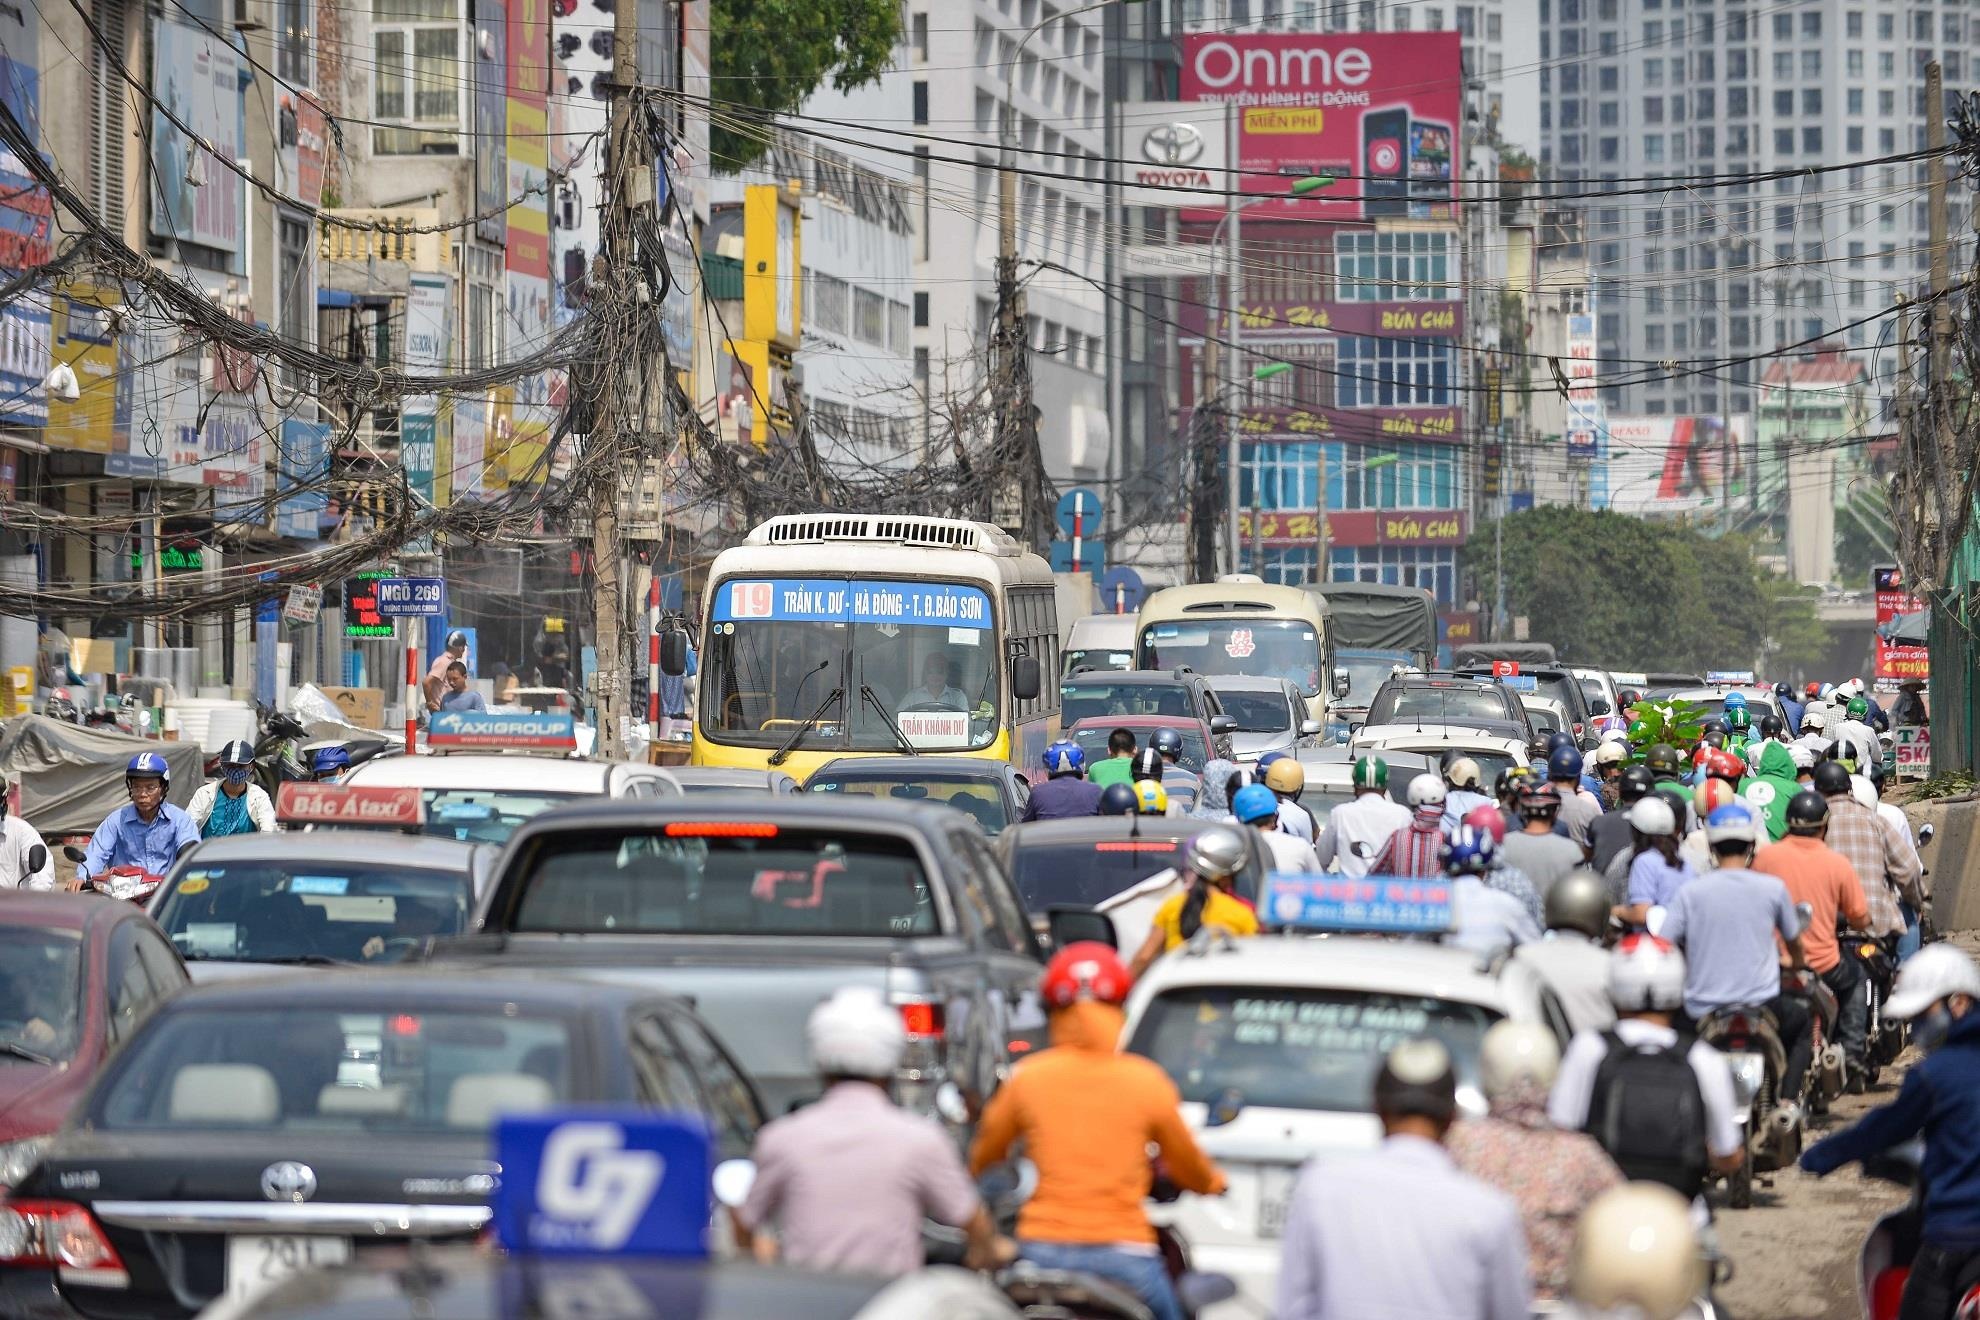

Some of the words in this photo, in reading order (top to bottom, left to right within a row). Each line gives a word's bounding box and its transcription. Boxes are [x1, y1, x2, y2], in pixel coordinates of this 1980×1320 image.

[1195, 42, 1372, 87] Onme
[1303, 92, 1319, 105] DI
[1137, 171, 1210, 186] TOYOTA
[1382, 306, 1416, 329] BÚN
[1382, 412, 1416, 433] BÚN
[1387, 515, 1421, 539] BÚN
[382, 582, 410, 601] NGÕ
[415, 585, 440, 601] 269
[734, 584, 770, 616] 19
[784, 584, 812, 613] TRẦN
[815, 592, 825, 613] K.
[828, 590, 844, 614] DƯ
[855, 588, 869, 615] HÀ
[873, 589, 903, 616] ĐÔNG
[913, 596, 922, 616] T.
[960, 597, 983, 620] SƠN
[452, 721, 567, 736] TAXIGROUP
[924, 717, 951, 736] KHÁNH
[953, 718, 965, 736] DƯ
